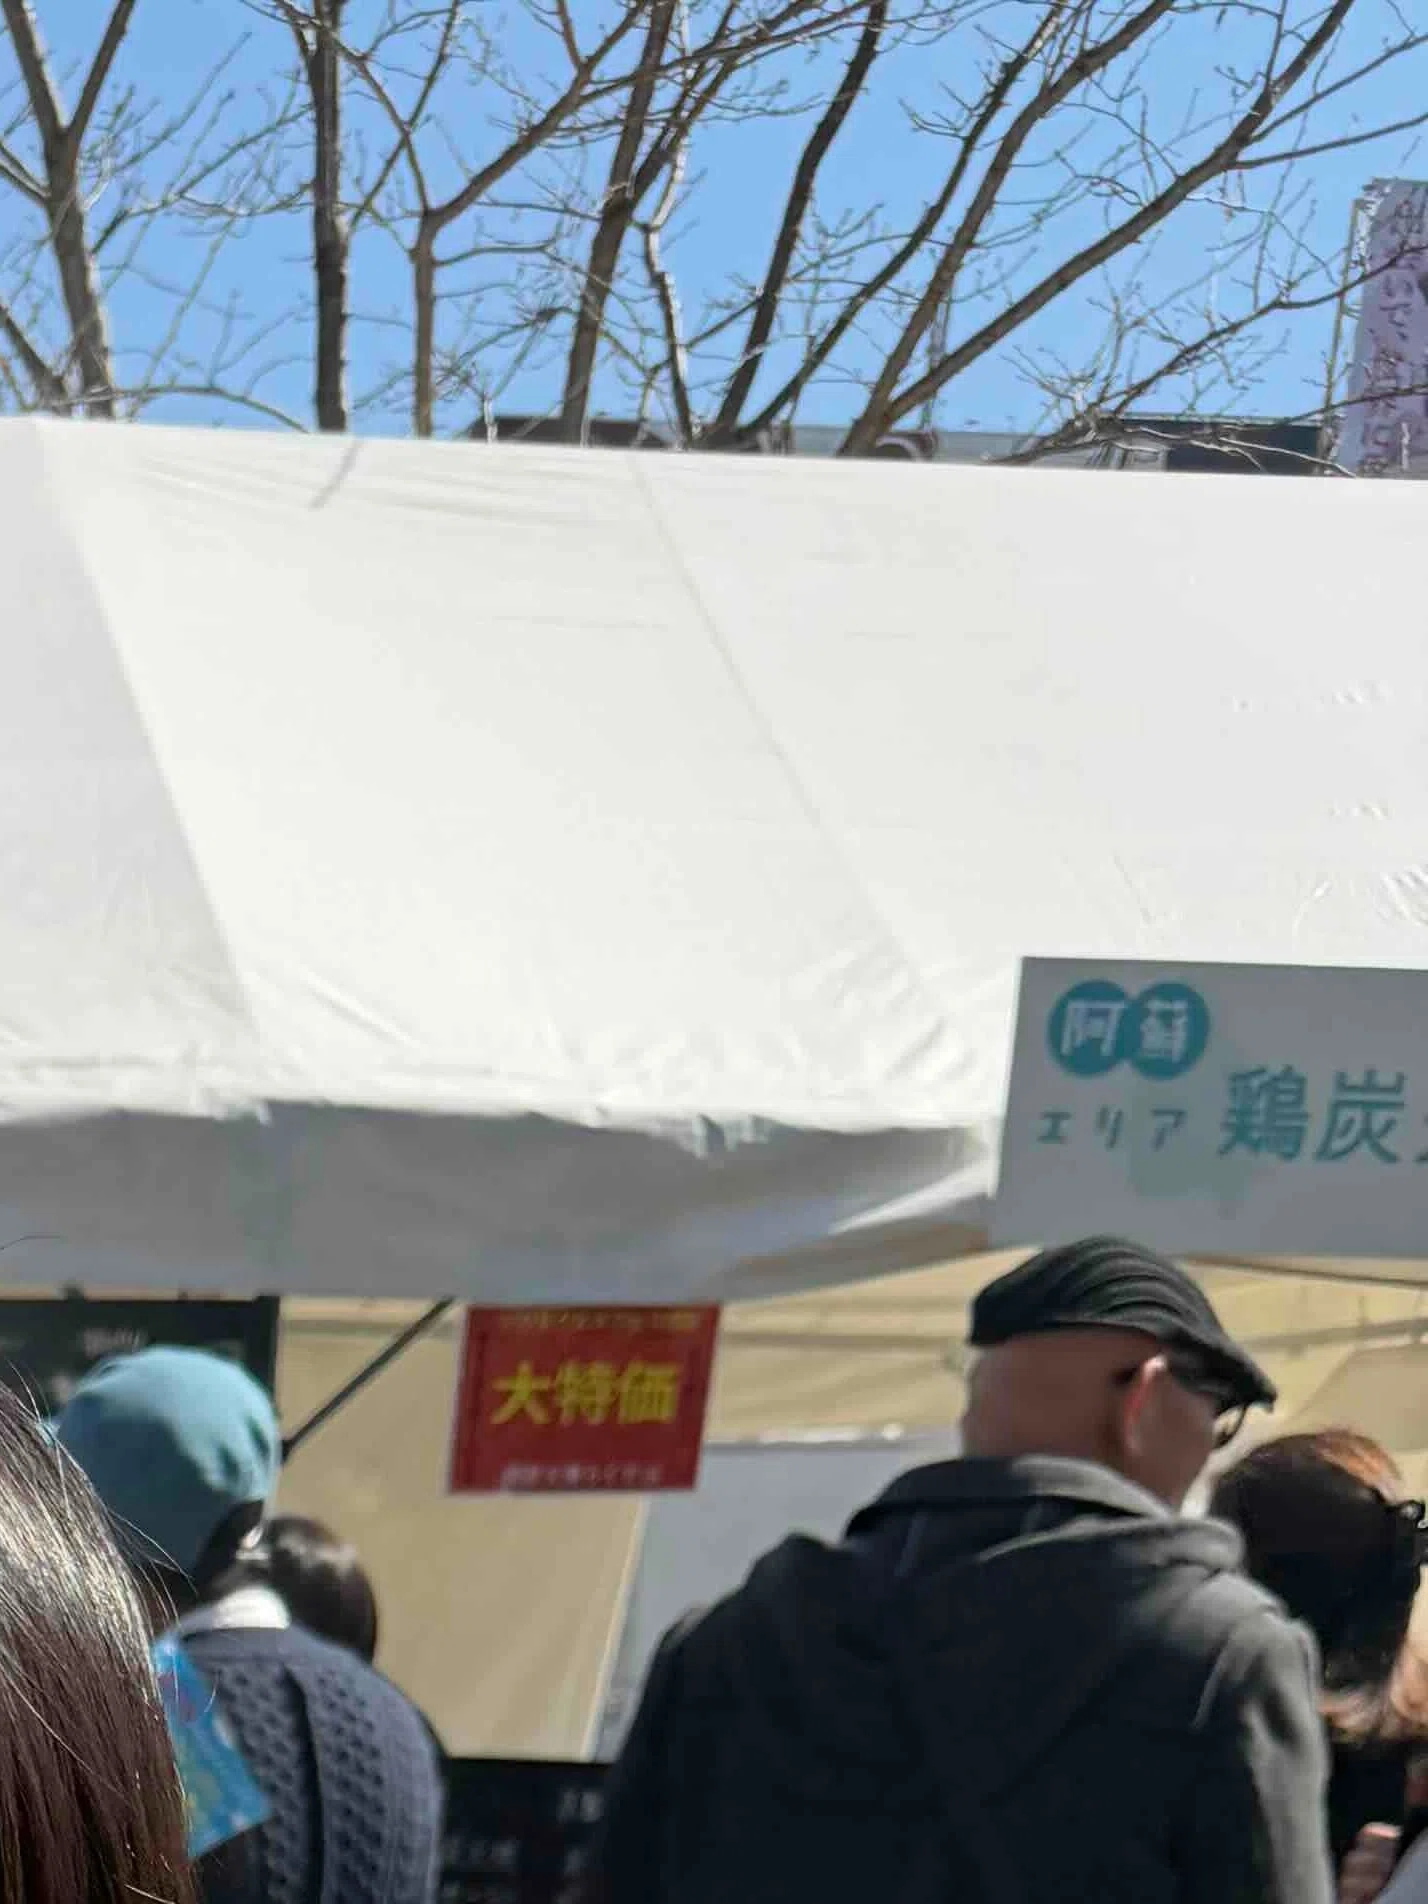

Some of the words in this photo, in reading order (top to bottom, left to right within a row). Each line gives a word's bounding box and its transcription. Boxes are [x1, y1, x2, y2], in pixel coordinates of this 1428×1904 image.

[1037, 1105, 1188, 1153] エリア
[1216, 1064, 1428, 1165] 鶏炭
[490, 1360, 680, 1426] 大特価
